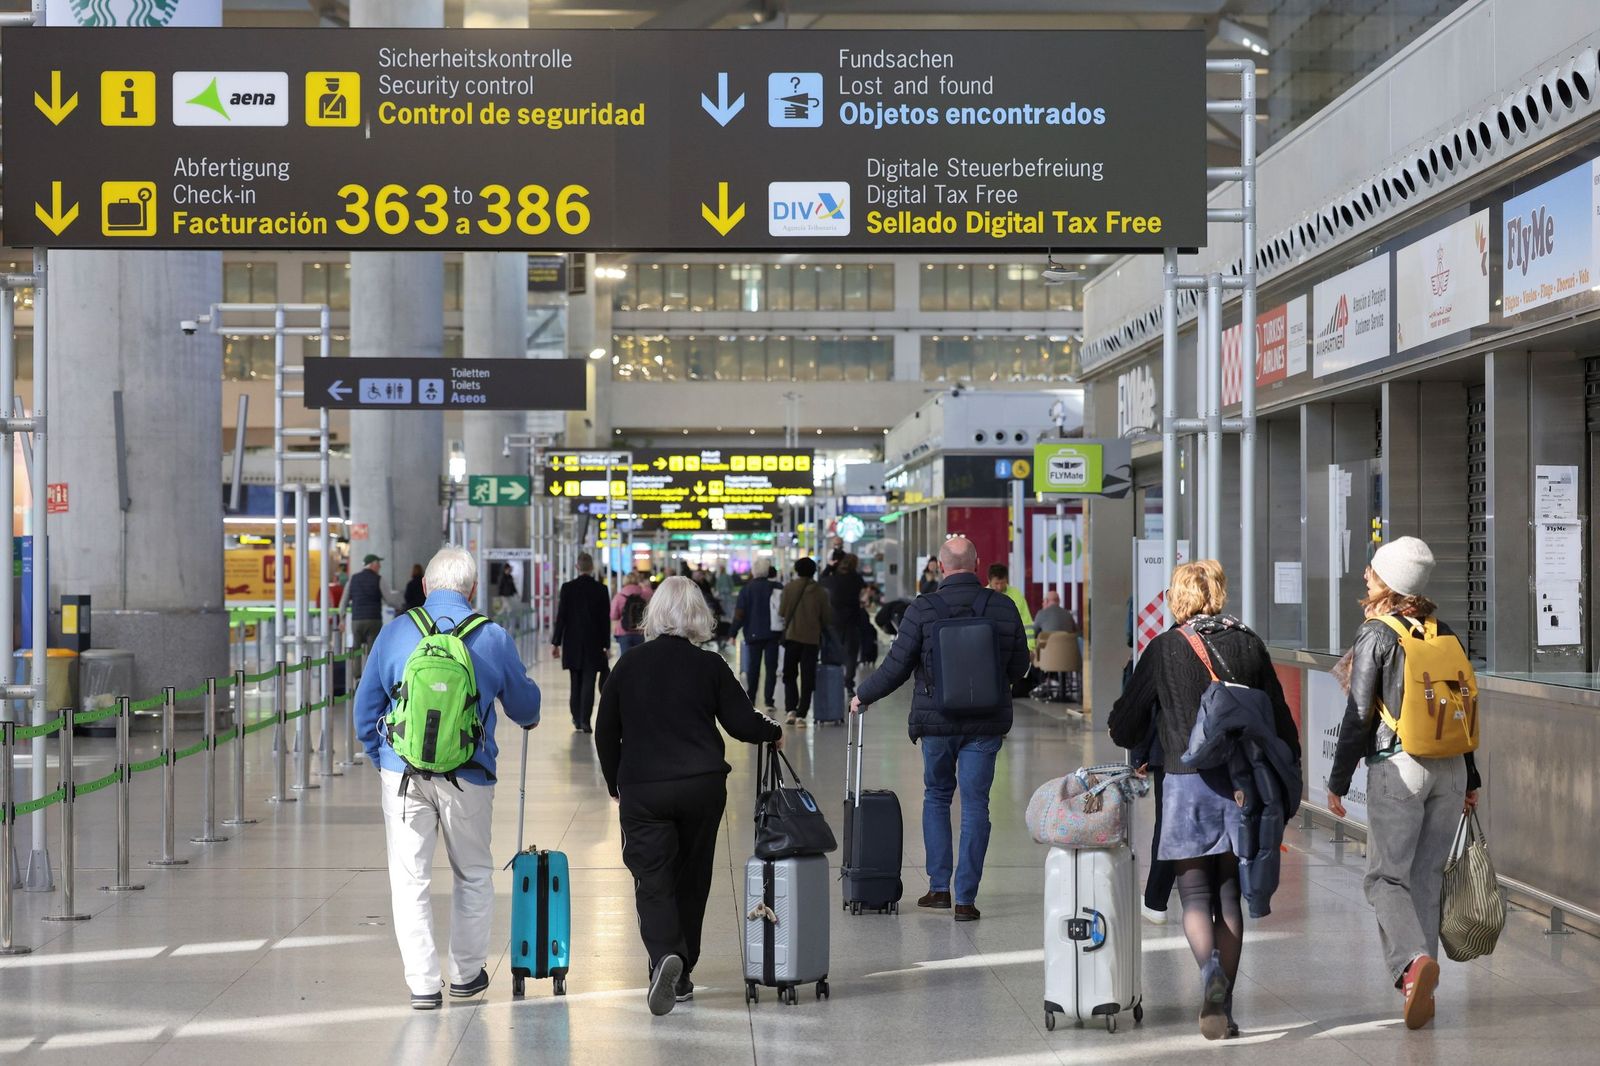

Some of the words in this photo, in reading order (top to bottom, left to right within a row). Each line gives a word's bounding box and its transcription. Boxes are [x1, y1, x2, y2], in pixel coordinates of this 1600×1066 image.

[379, 47, 573, 69] Sicherheitskontrolle
[839, 49, 954, 69] Fundsachen
[378, 75, 460, 98] Security
[464, 74, 534, 96] control
[839, 76, 883, 96] Lost
[893, 76, 929, 96] and
[938, 75, 994, 96] found
[230, 93, 275, 105] aena
[378, 101, 473, 126] Control
[480, 102, 511, 126] de
[517, 101, 645, 130] seguridad
[839, 102, 939, 130] Objetos
[945, 102, 1106, 126] encontrados
[173, 157, 290, 182] Abfertigung
[867, 158, 939, 182] Digitale
[947, 158, 1104, 182] Steuerbefreiung
[173, 184, 256, 205] Check-in
[453, 185, 473, 205] to
[867, 185, 927, 208] Digital
[933, 185, 969, 204] Tax
[976, 185, 1018, 204] Free
[173, 211, 328, 235] Facturación
[336, 183, 448, 236] 363
[456, 216, 471, 235] a
[477, 183, 591, 236] 386
[866, 210, 958, 234] Sellado
[966, 210, 1044, 239] Digital
[1051, 211, 1098, 234] Tax
[1106, 211, 1162, 234] Free
[1507, 206, 1554, 276] FlyMe
[451, 368, 490, 378] Toiletten
[451, 380, 481, 390] Toilets
[451, 392, 487, 404] Aseos
[1050, 471, 1083, 480] FLYMate
